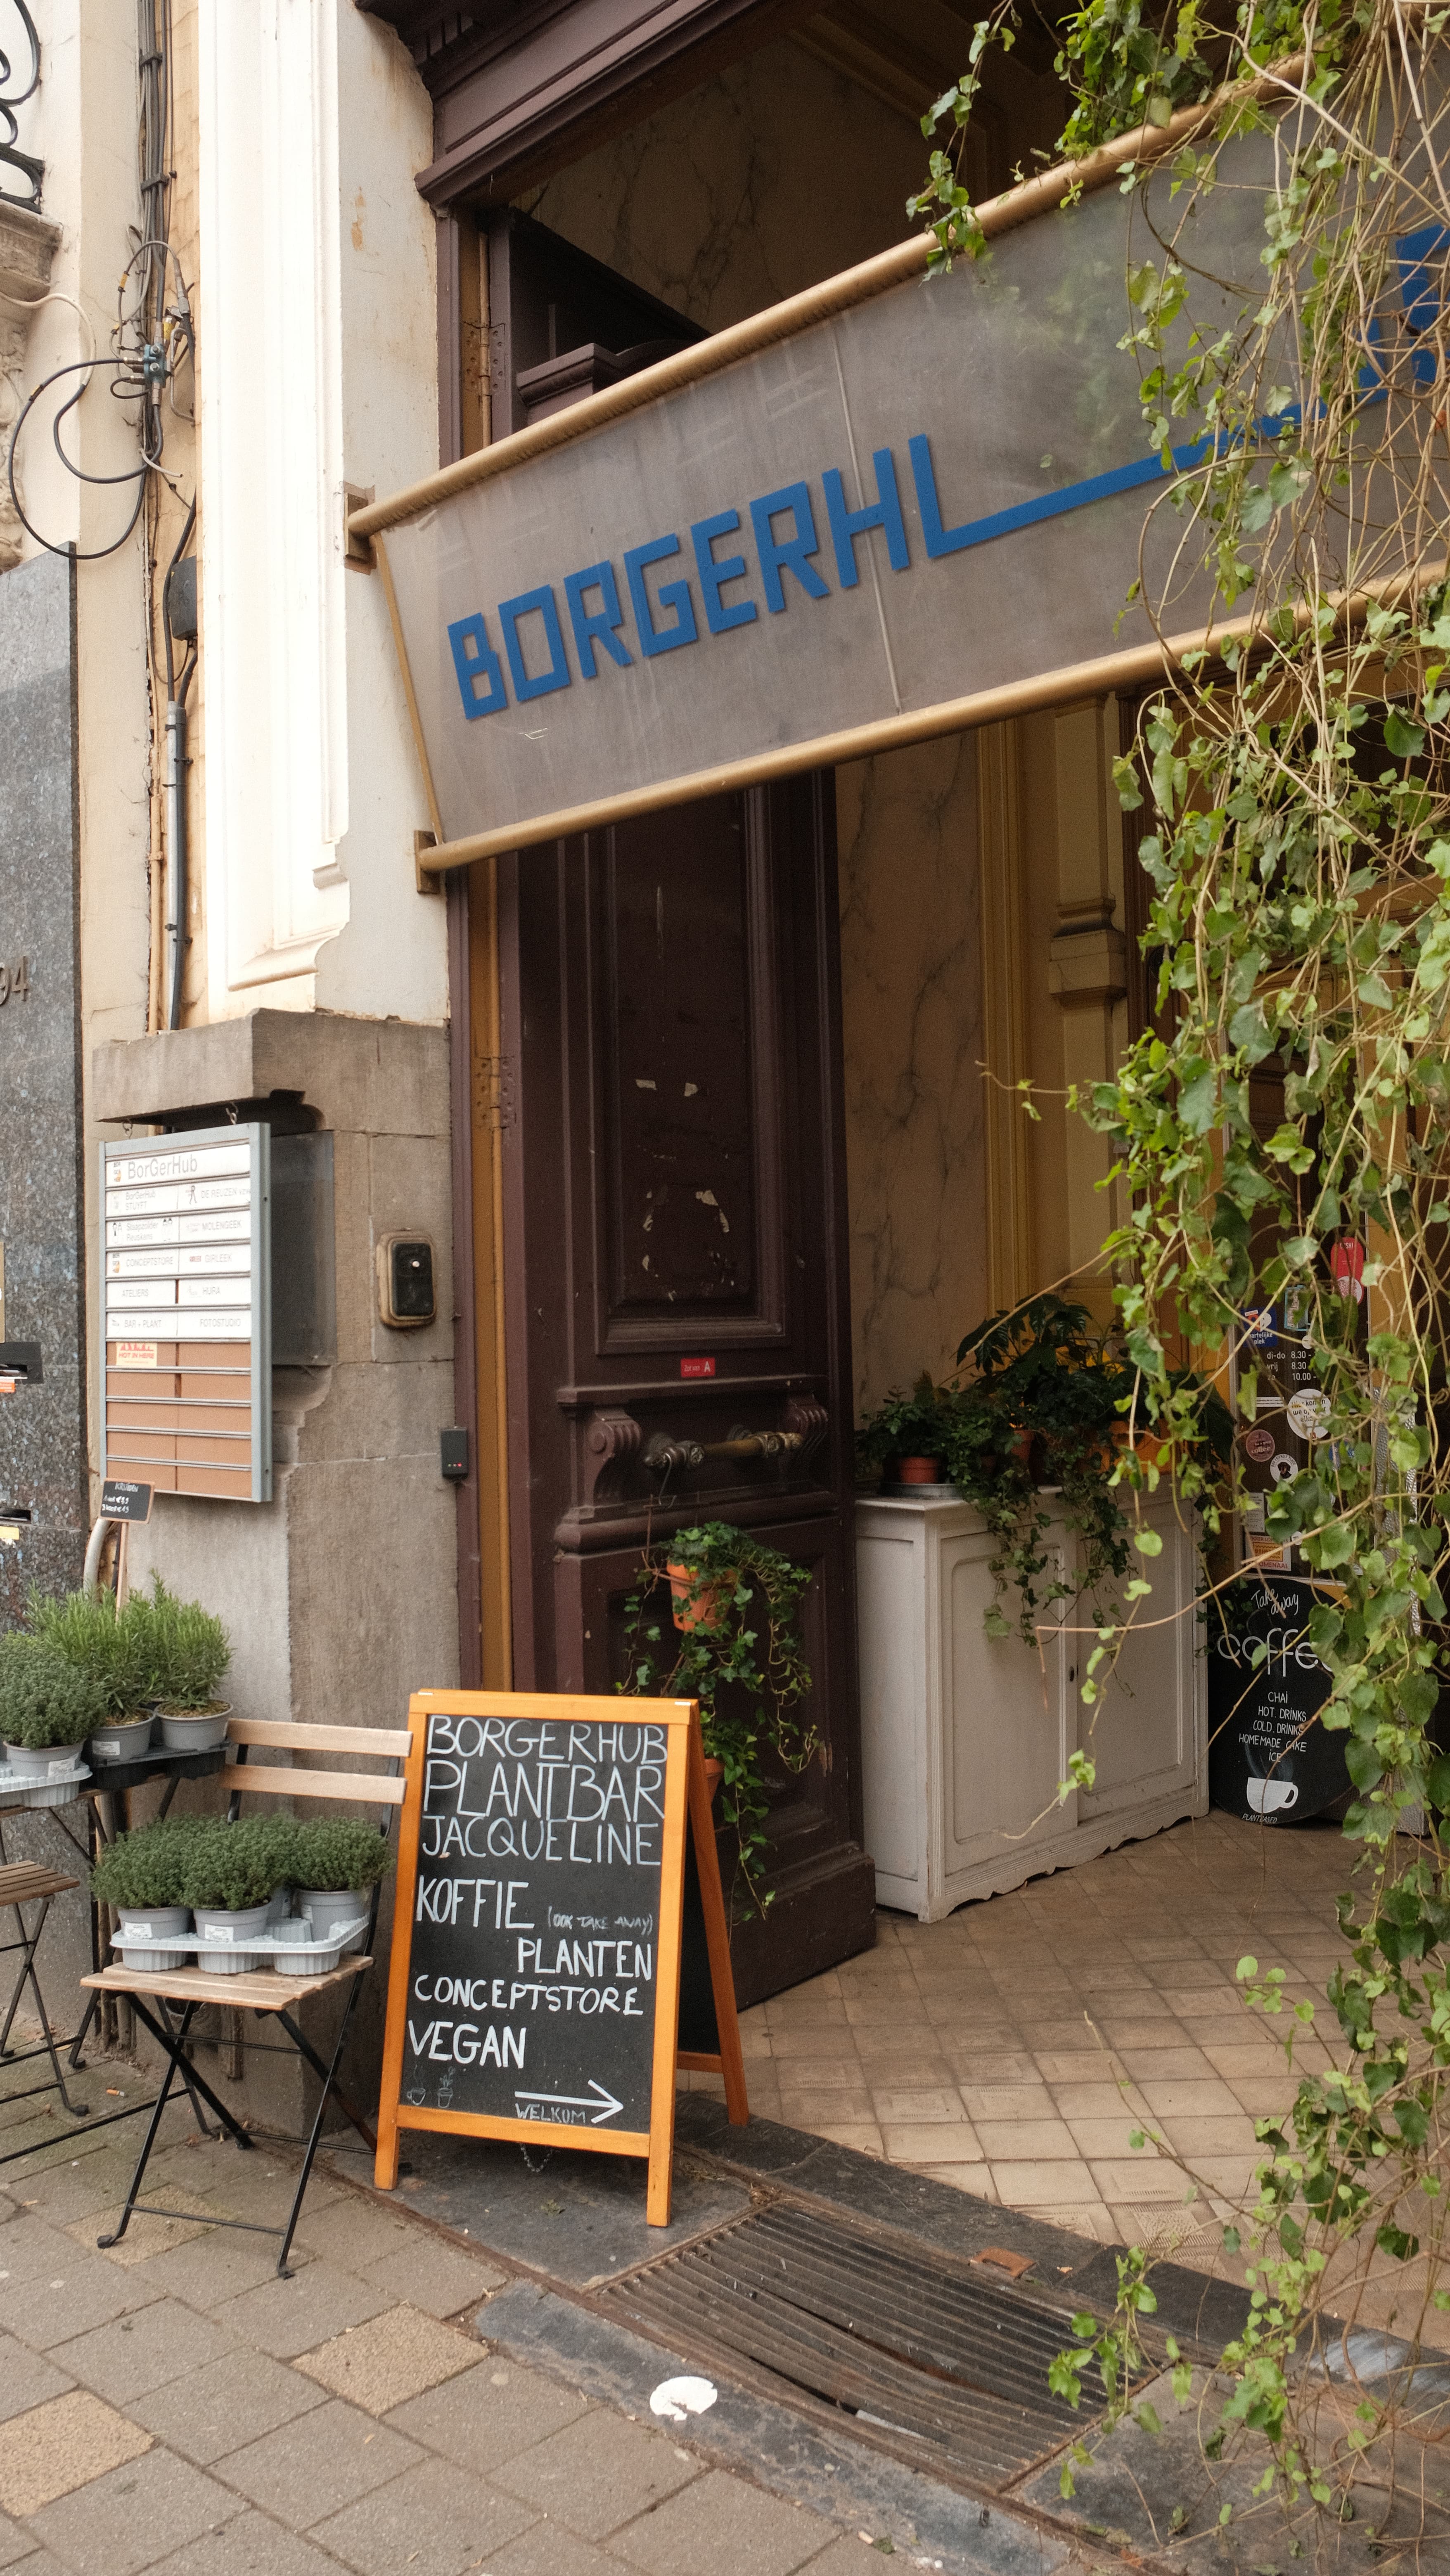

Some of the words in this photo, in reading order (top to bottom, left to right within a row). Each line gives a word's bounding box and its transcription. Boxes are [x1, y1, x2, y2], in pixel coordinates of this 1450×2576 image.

[128, 1153, 197, 1179] BorGerHub
[202, 1219, 242, 1231] MOLENGEEK
[126, 1256, 173, 1267] CONCEPTSTORE
[122, 1288, 149, 1297] ATELIERS
[124, 1319, 136, 1328] BAR
[142, 1319, 162, 1328] PLANT
[199, 1318, 241, 1328] FOTOSTUDIO
[704, 1361, 711, 1372] A
[1267, 1362, 1278, 1372] vrij
[1251, 1589, 1278, 1609] Take
[1271, 1593, 1299, 1615] away
[1218, 1627, 1333, 1677] coffe
[427, 1714, 668, 1765] BORGERHUB
[422, 1815, 661, 1865] JACQUELINE
[415, 1875, 535, 1929] KOFFIE
[577, 1915, 608, 1930] TAKE
[518, 1937, 652, 1981] PLANTEN
[415, 1975, 643, 2015] CONCEPTSTORE
[408, 2020, 526, 2069] VEGAN
[515, 2103, 586, 2124] WELKOM
